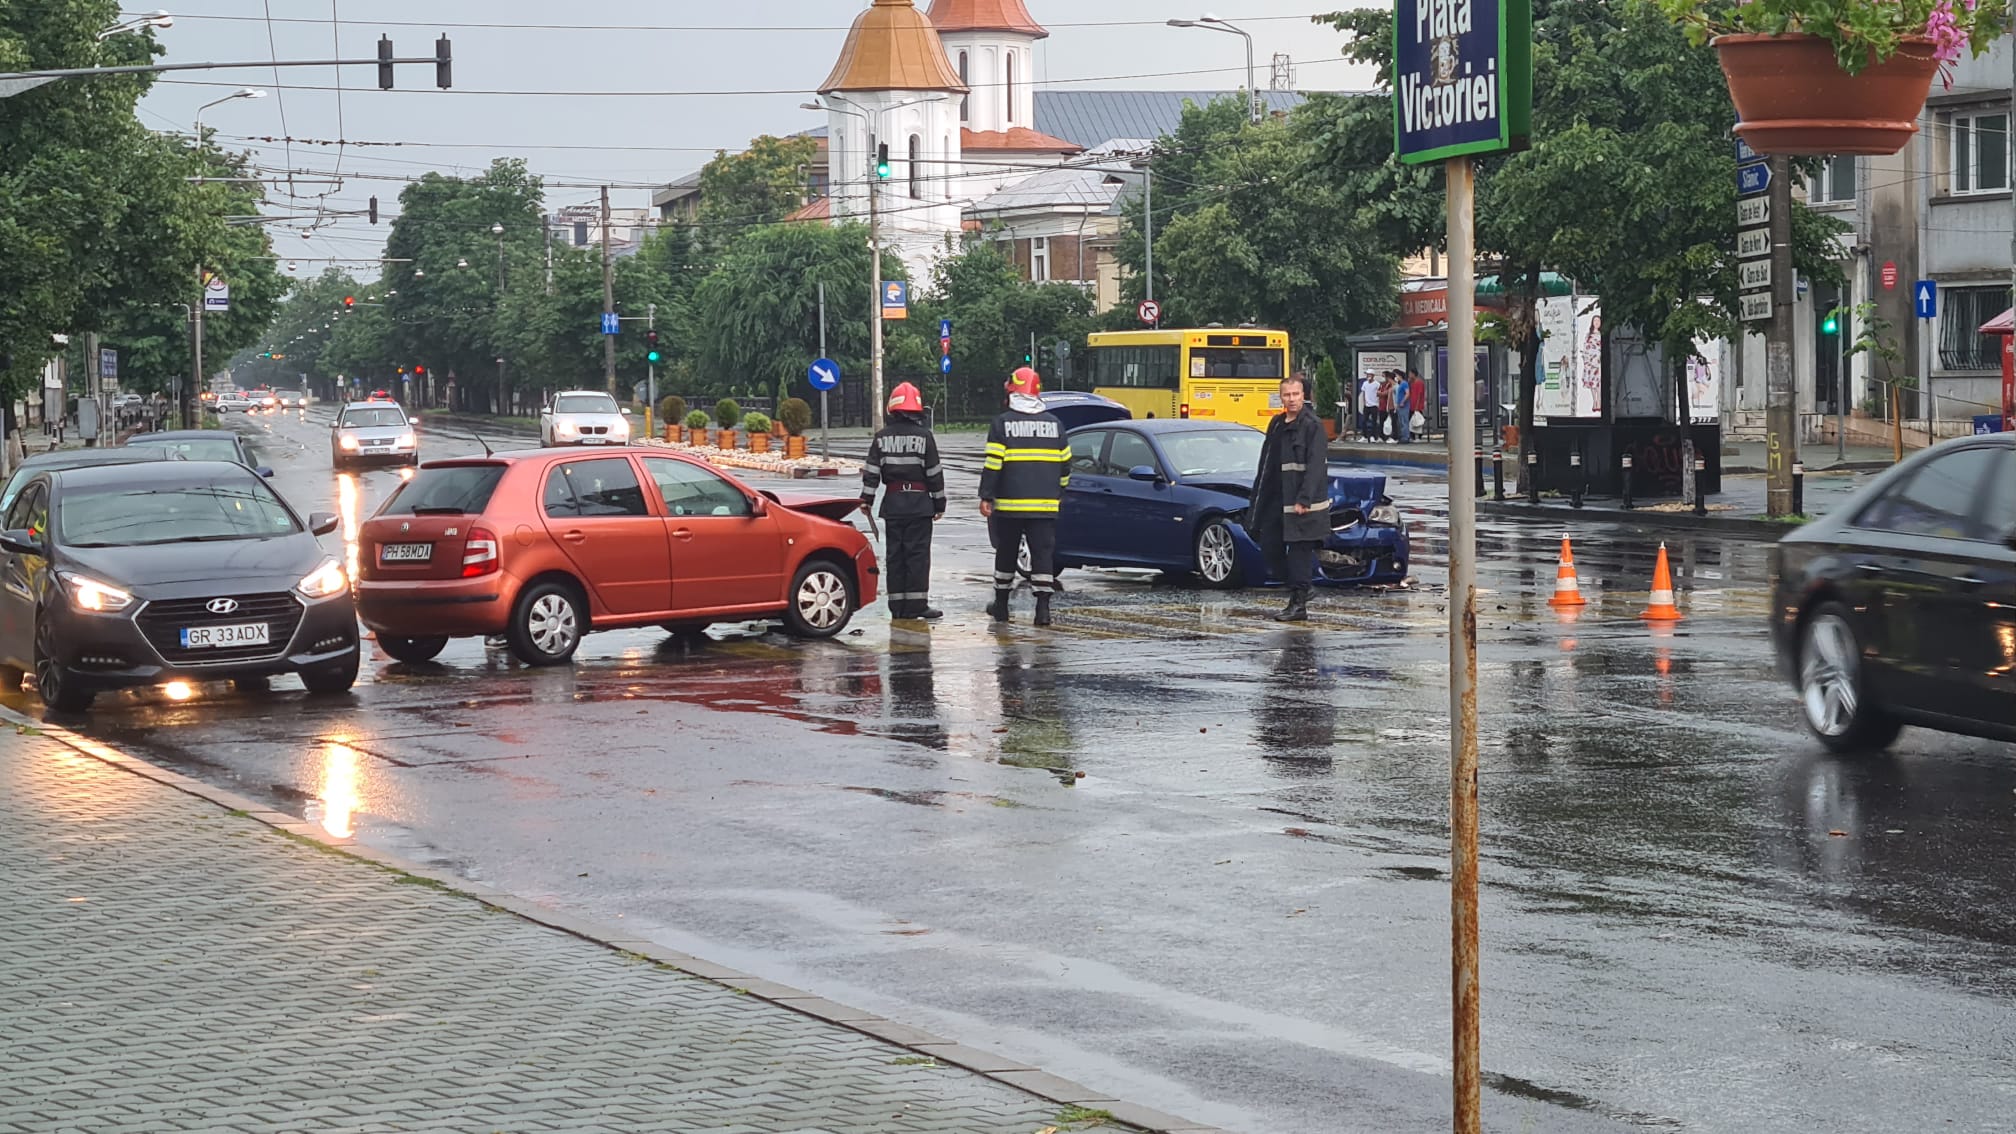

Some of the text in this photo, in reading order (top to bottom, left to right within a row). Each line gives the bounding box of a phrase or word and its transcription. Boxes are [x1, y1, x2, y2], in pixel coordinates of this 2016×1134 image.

[1401, 57, 1495, 133] Victoriei
[1004, 421, 1058, 438] POMPIERI
[385, 544, 399, 558] PH
[189, 624, 266, 644] GR 33 ADX
